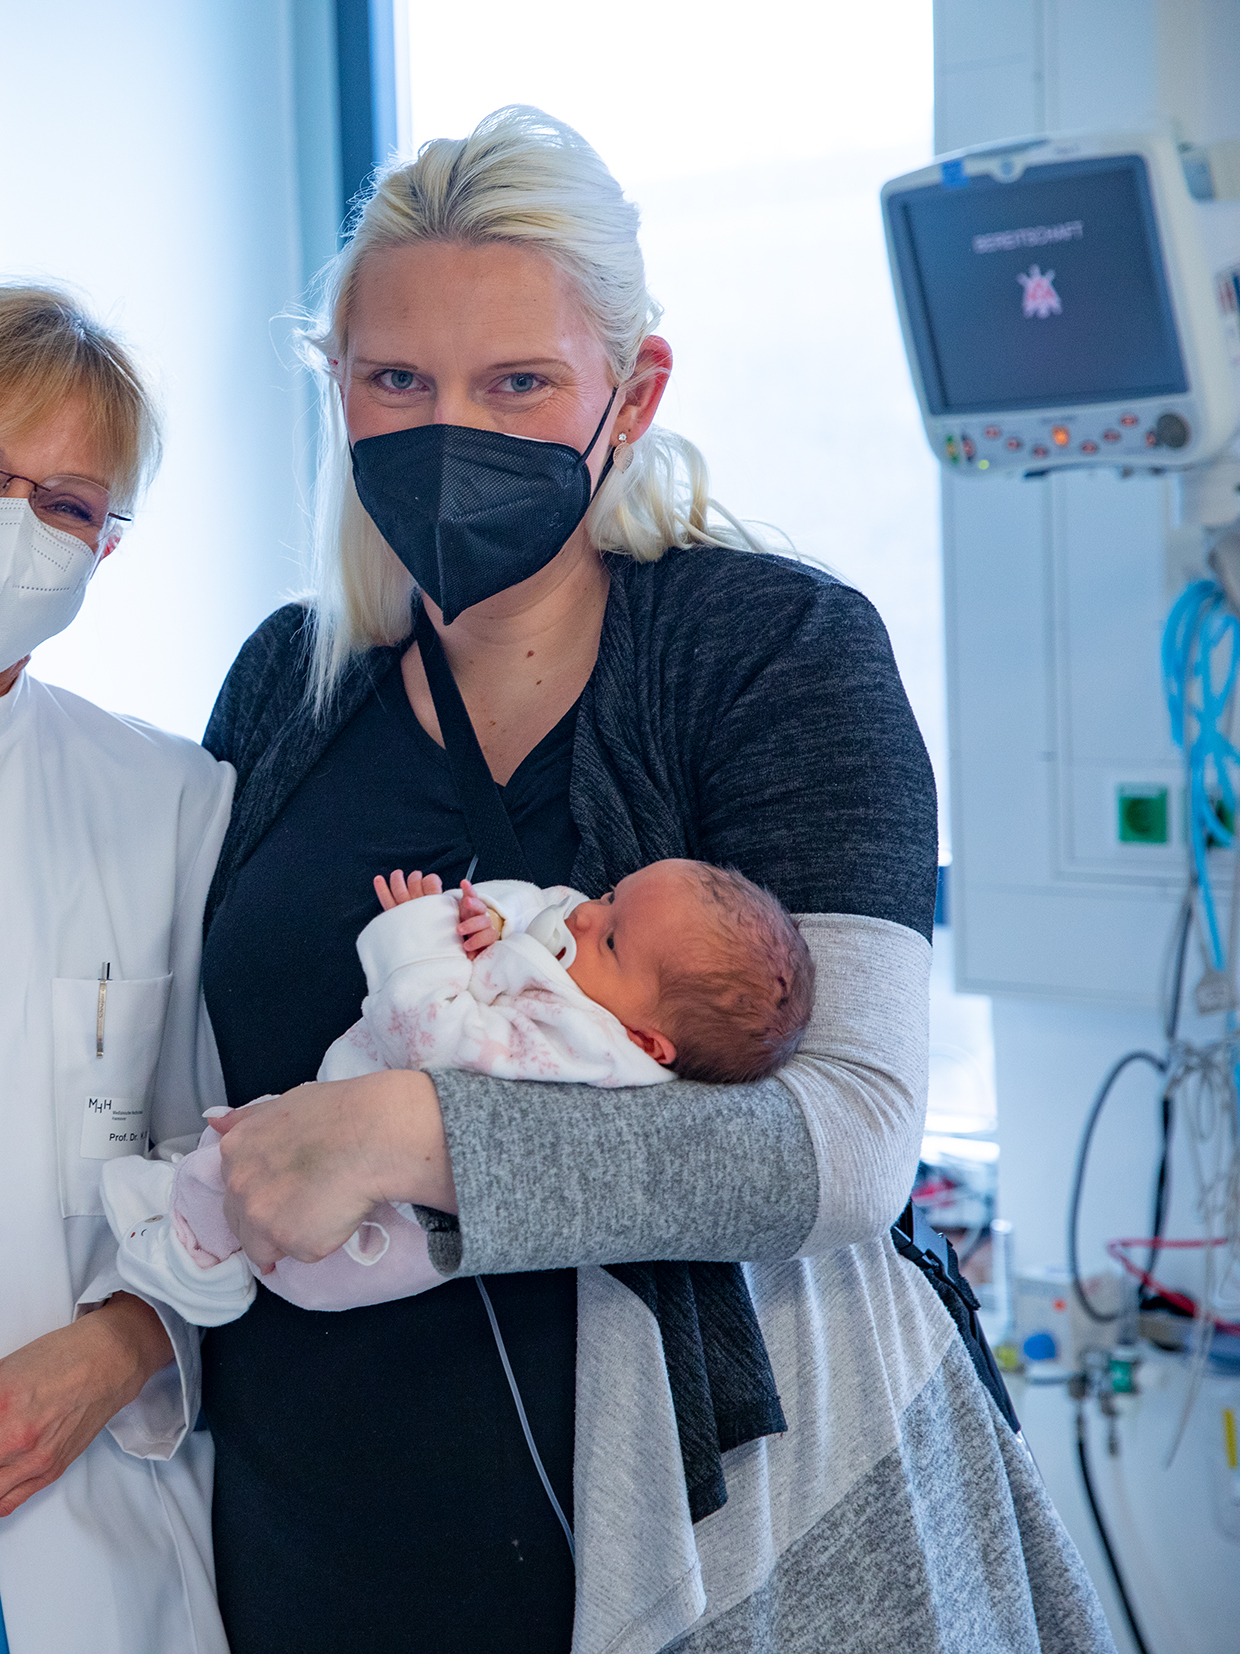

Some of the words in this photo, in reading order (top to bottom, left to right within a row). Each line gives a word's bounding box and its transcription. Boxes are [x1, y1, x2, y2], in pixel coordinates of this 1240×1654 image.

[972, 220, 1085, 254] BEREITSCHAFT
[109, 1133, 128, 1141] Prof.
[130, 1133, 138, 1141] Dr.
